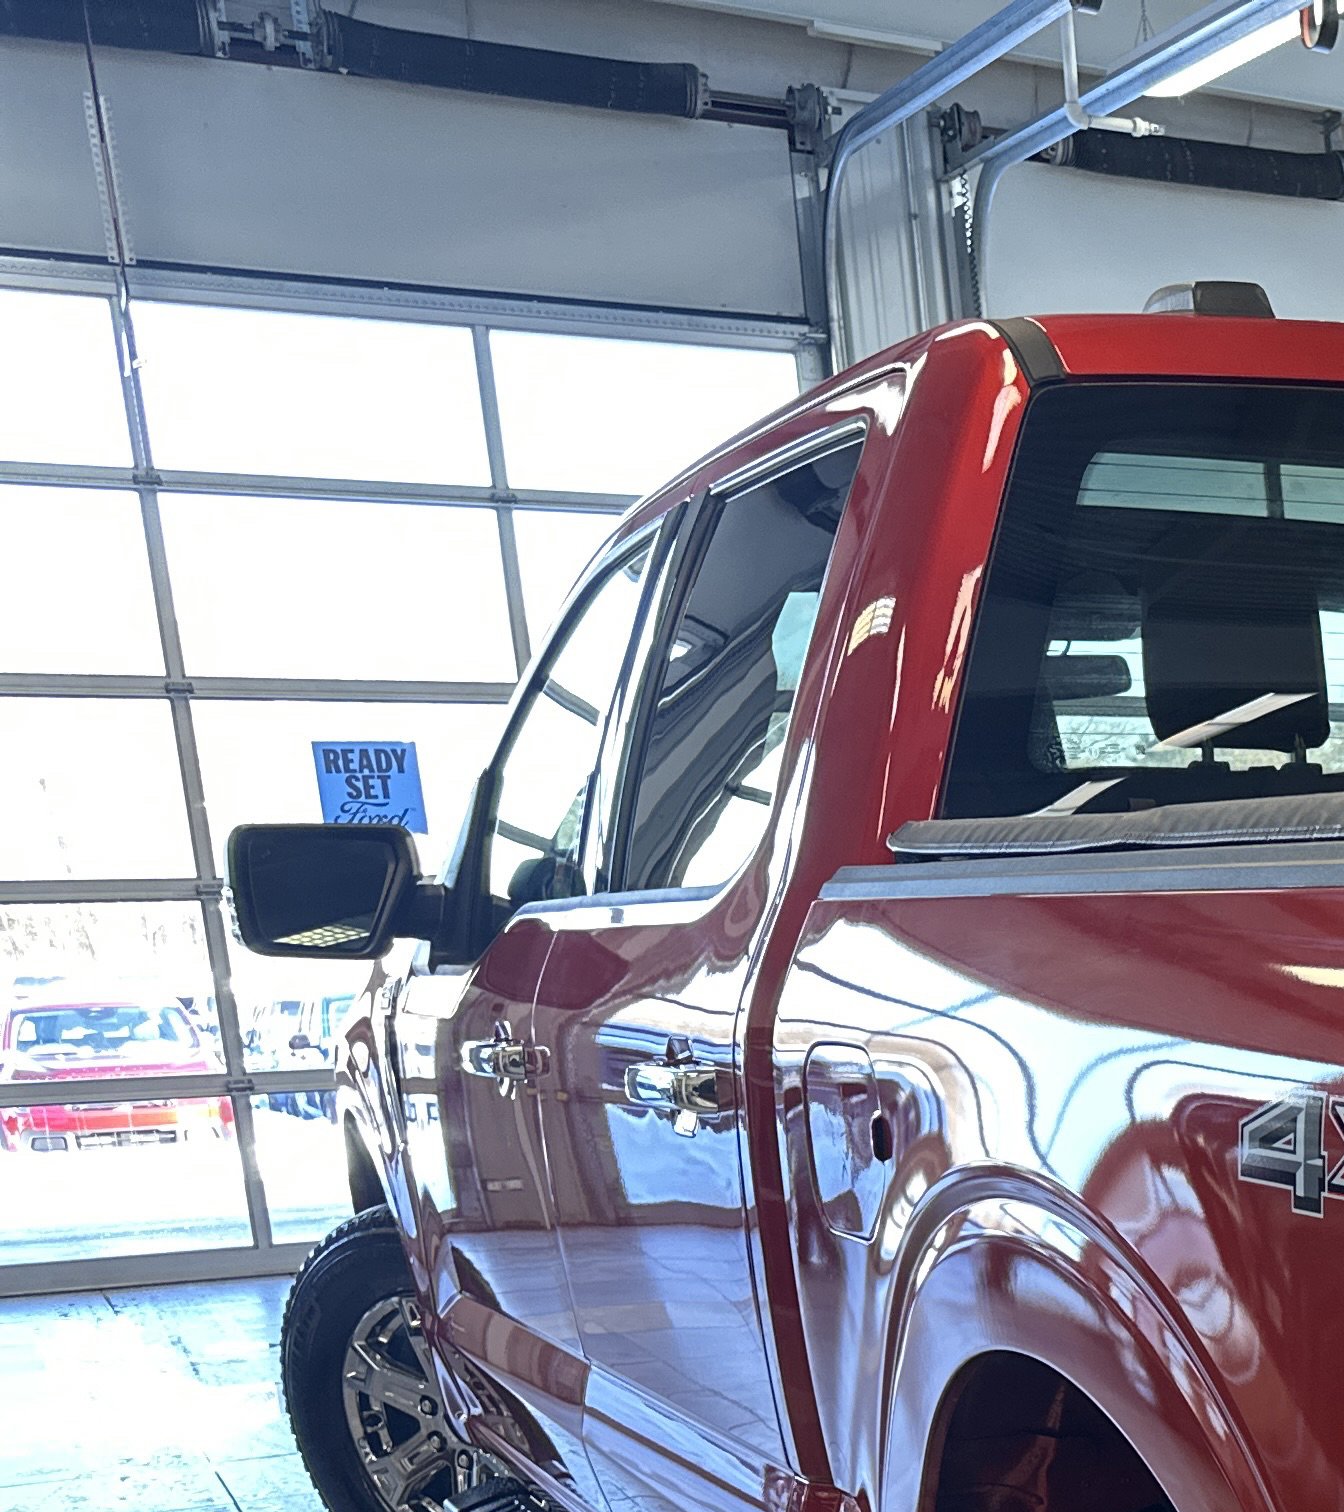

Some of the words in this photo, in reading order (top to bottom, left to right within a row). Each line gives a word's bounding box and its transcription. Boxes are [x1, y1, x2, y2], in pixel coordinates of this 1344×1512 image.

[322, 748, 407, 774] READY
[345, 775, 391, 799] SET
[334, 801, 410, 826] Ford
